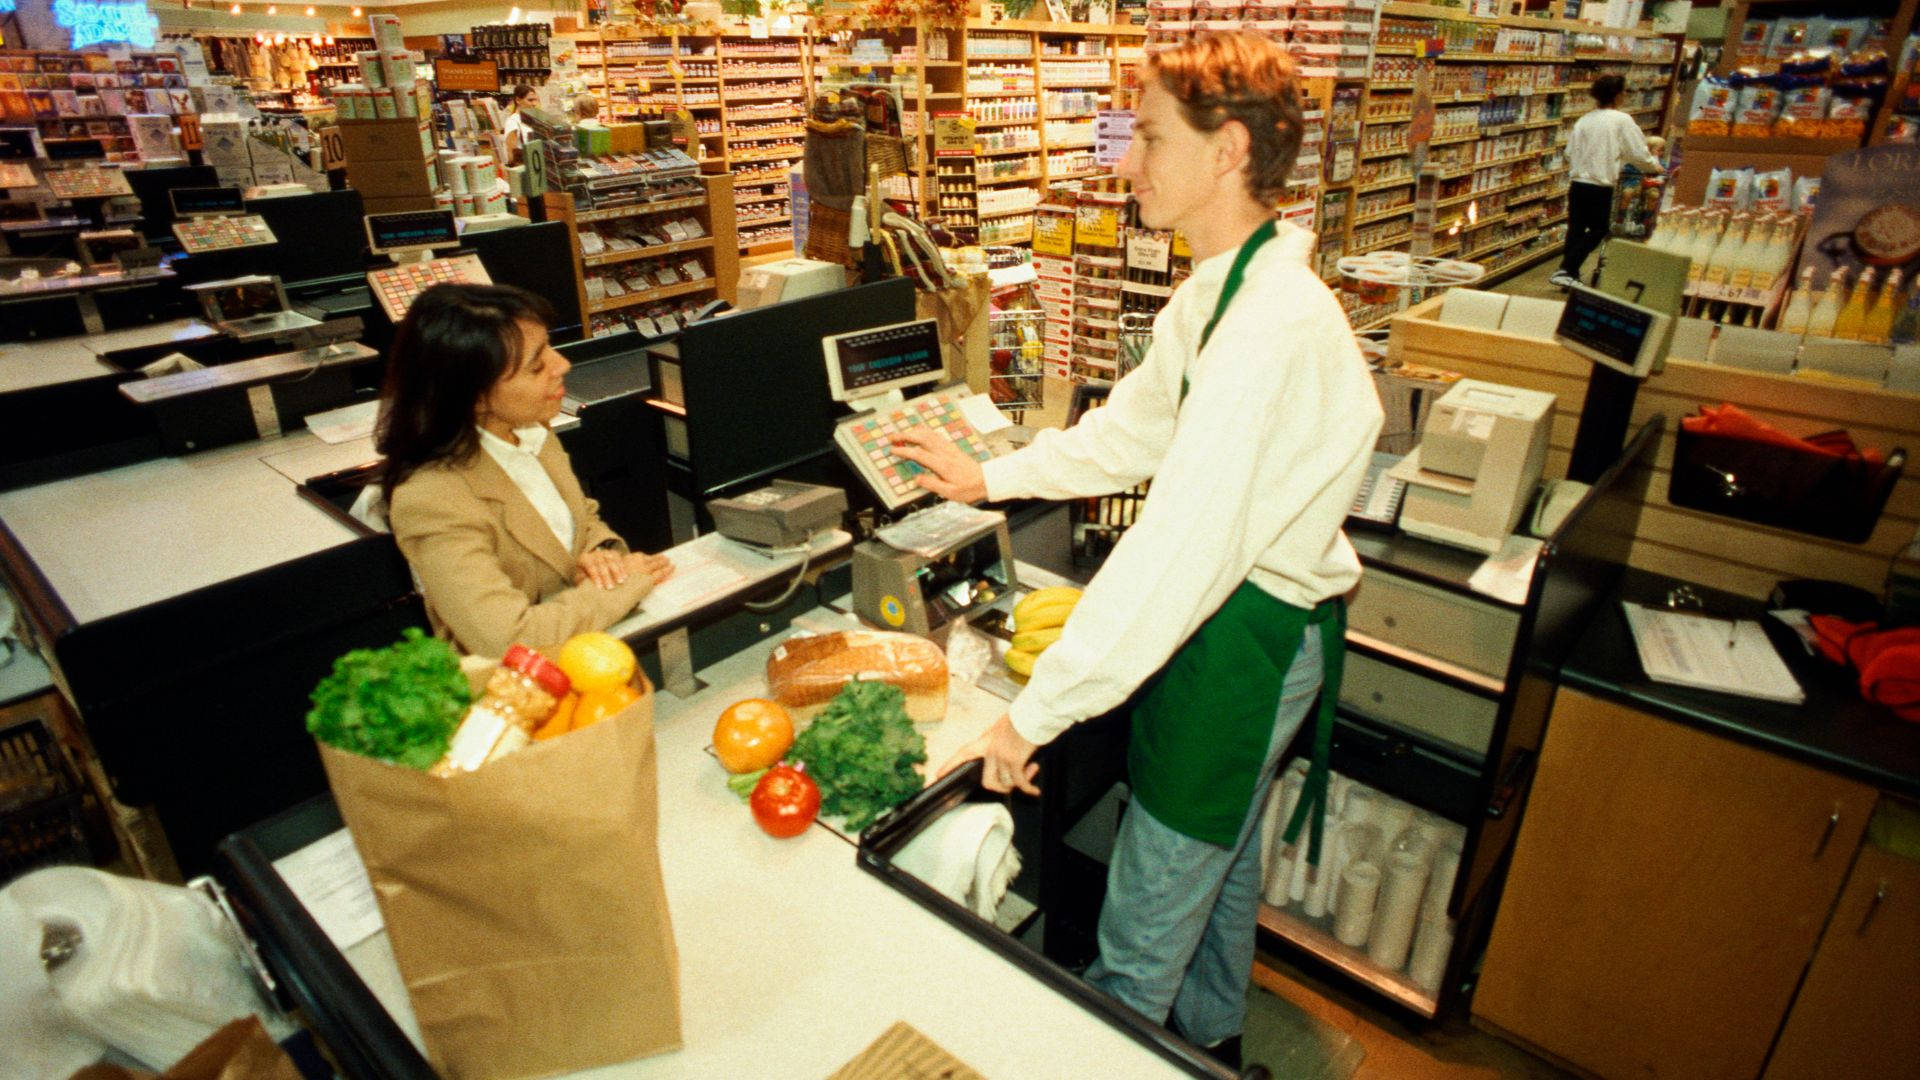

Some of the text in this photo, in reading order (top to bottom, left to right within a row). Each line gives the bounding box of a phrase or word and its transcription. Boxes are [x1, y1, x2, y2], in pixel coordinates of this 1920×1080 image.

[183, 117, 200, 145] 11
[323, 133, 344, 163] 10
[531, 149, 542, 188] 9
[1624, 280, 1646, 304] 7
